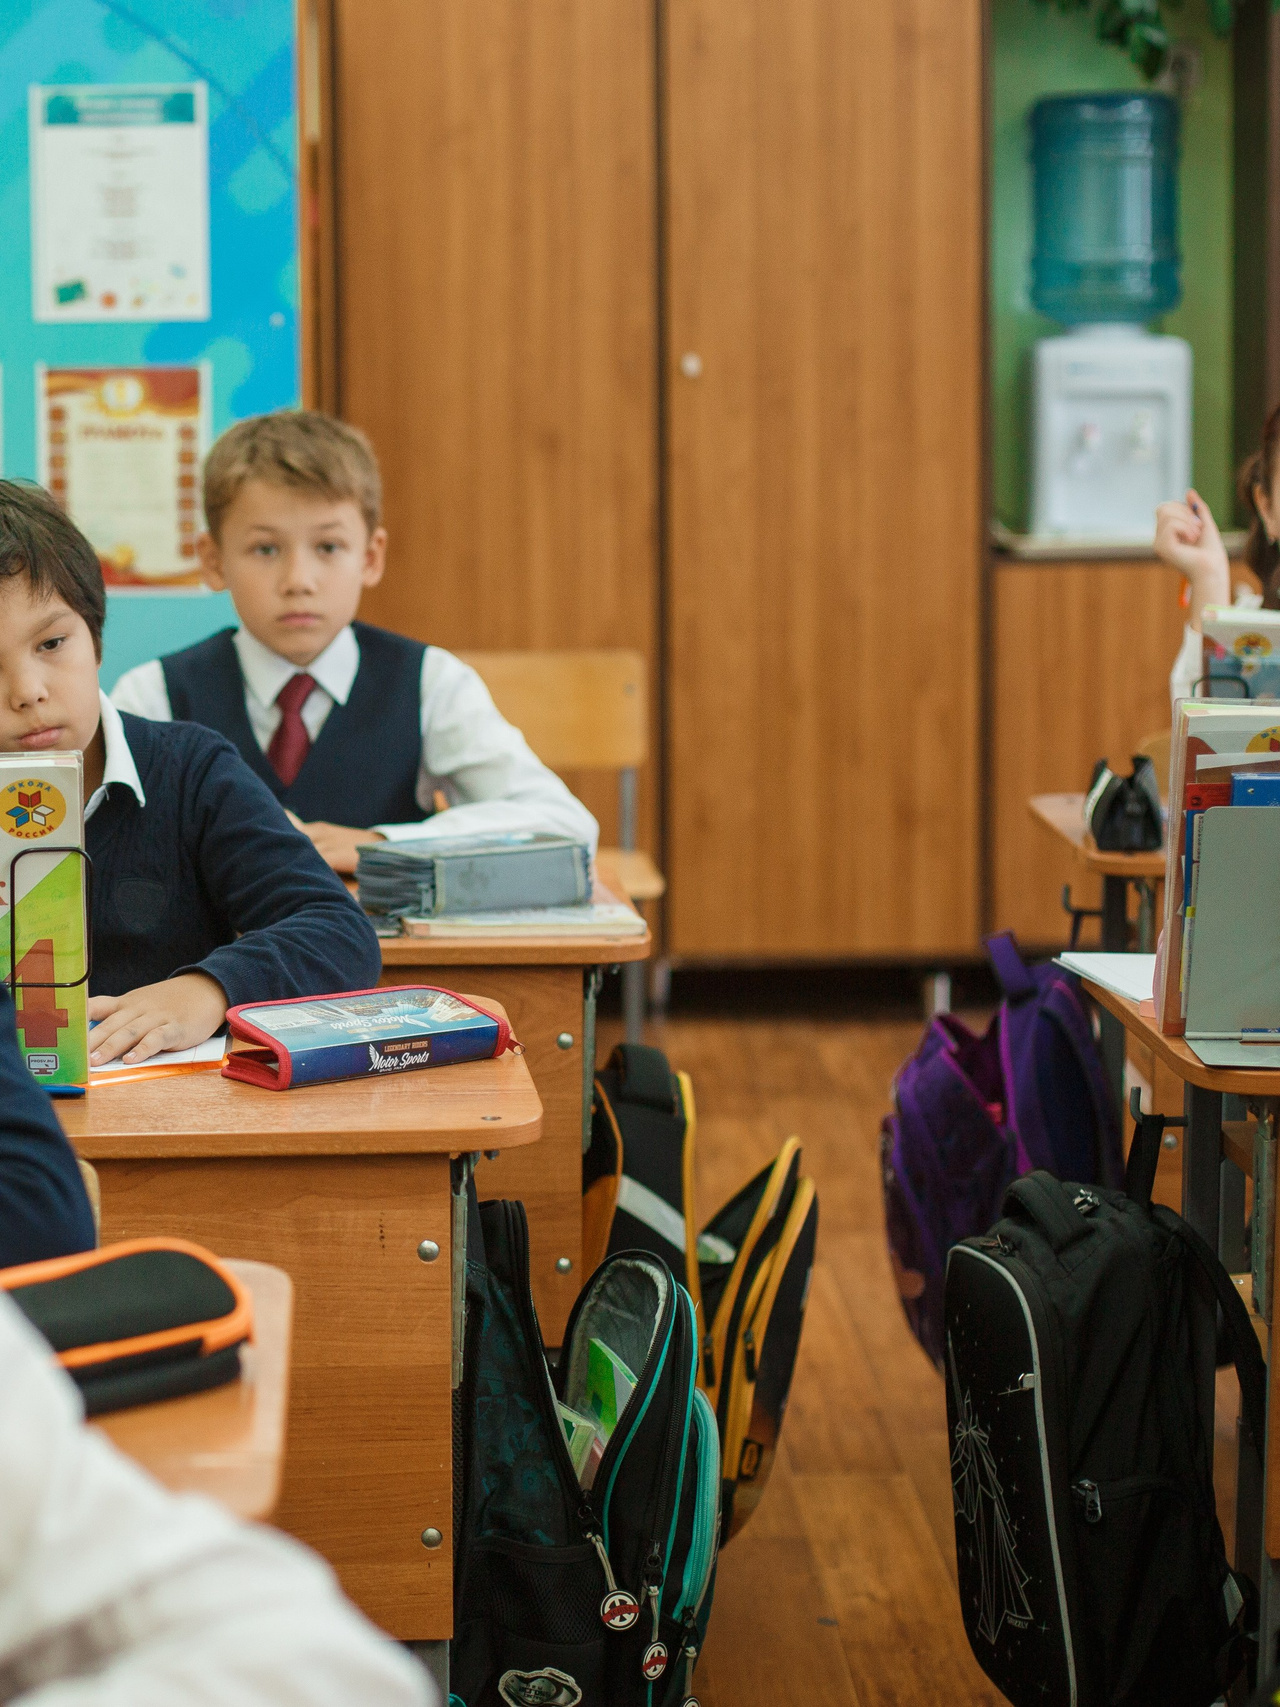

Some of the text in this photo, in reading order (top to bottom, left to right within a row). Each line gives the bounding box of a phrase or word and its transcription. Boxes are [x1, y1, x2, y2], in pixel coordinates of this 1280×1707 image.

[7, 780, 52, 793] ШКОЛА
[8, 825, 55, 838] РОССИИ
[3, 939, 69, 1048] 4
[369, 1051, 430, 1072] Motor Sports
